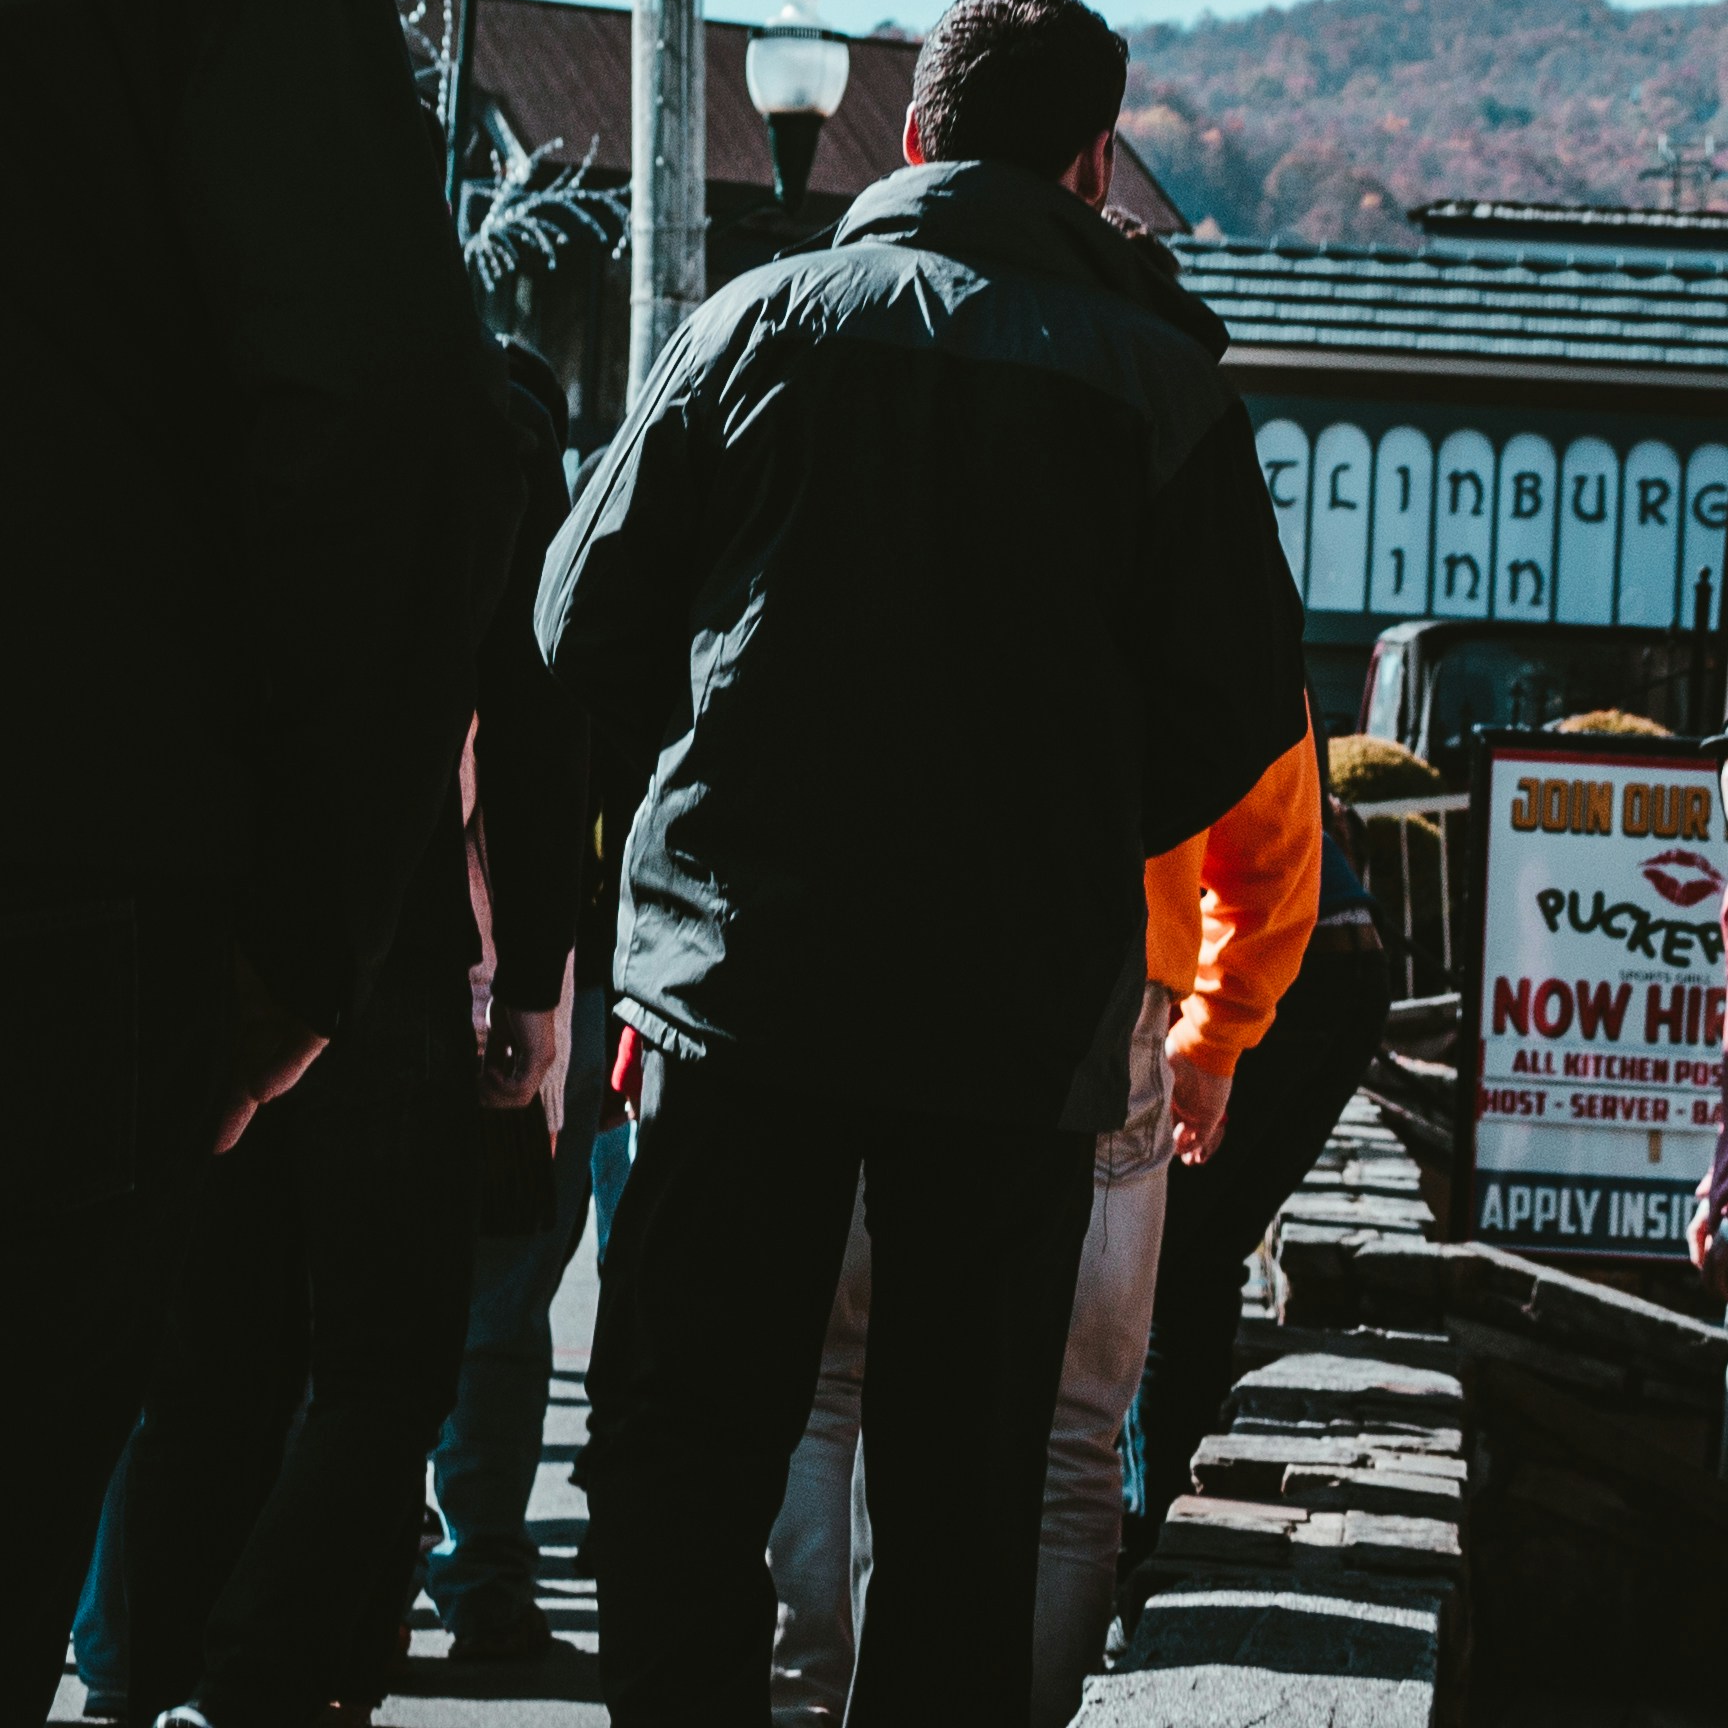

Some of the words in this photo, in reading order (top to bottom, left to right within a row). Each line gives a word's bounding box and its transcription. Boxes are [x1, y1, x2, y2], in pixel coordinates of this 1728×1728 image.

[1265, 459, 1727, 531] TLINBURG
[1511, 777, 1614, 835] JOIN
[1622, 784, 1712, 840] OUR
[1536, 887, 1725, 969] PUCKER
[1491, 974, 1632, 1041] NOW
[1644, 983, 1726, 1047] HIR
[1512, 1048, 1555, 1075] ALL
[1564, 1052, 1670, 1083] KITCHEN
[1674, 1060, 1724, 1087] POS
[1483, 1088, 1548, 1116] HOST
[1569, 1093, 1670, 1122] SERVER
[1480, 1183, 1601, 1236] APPLY
